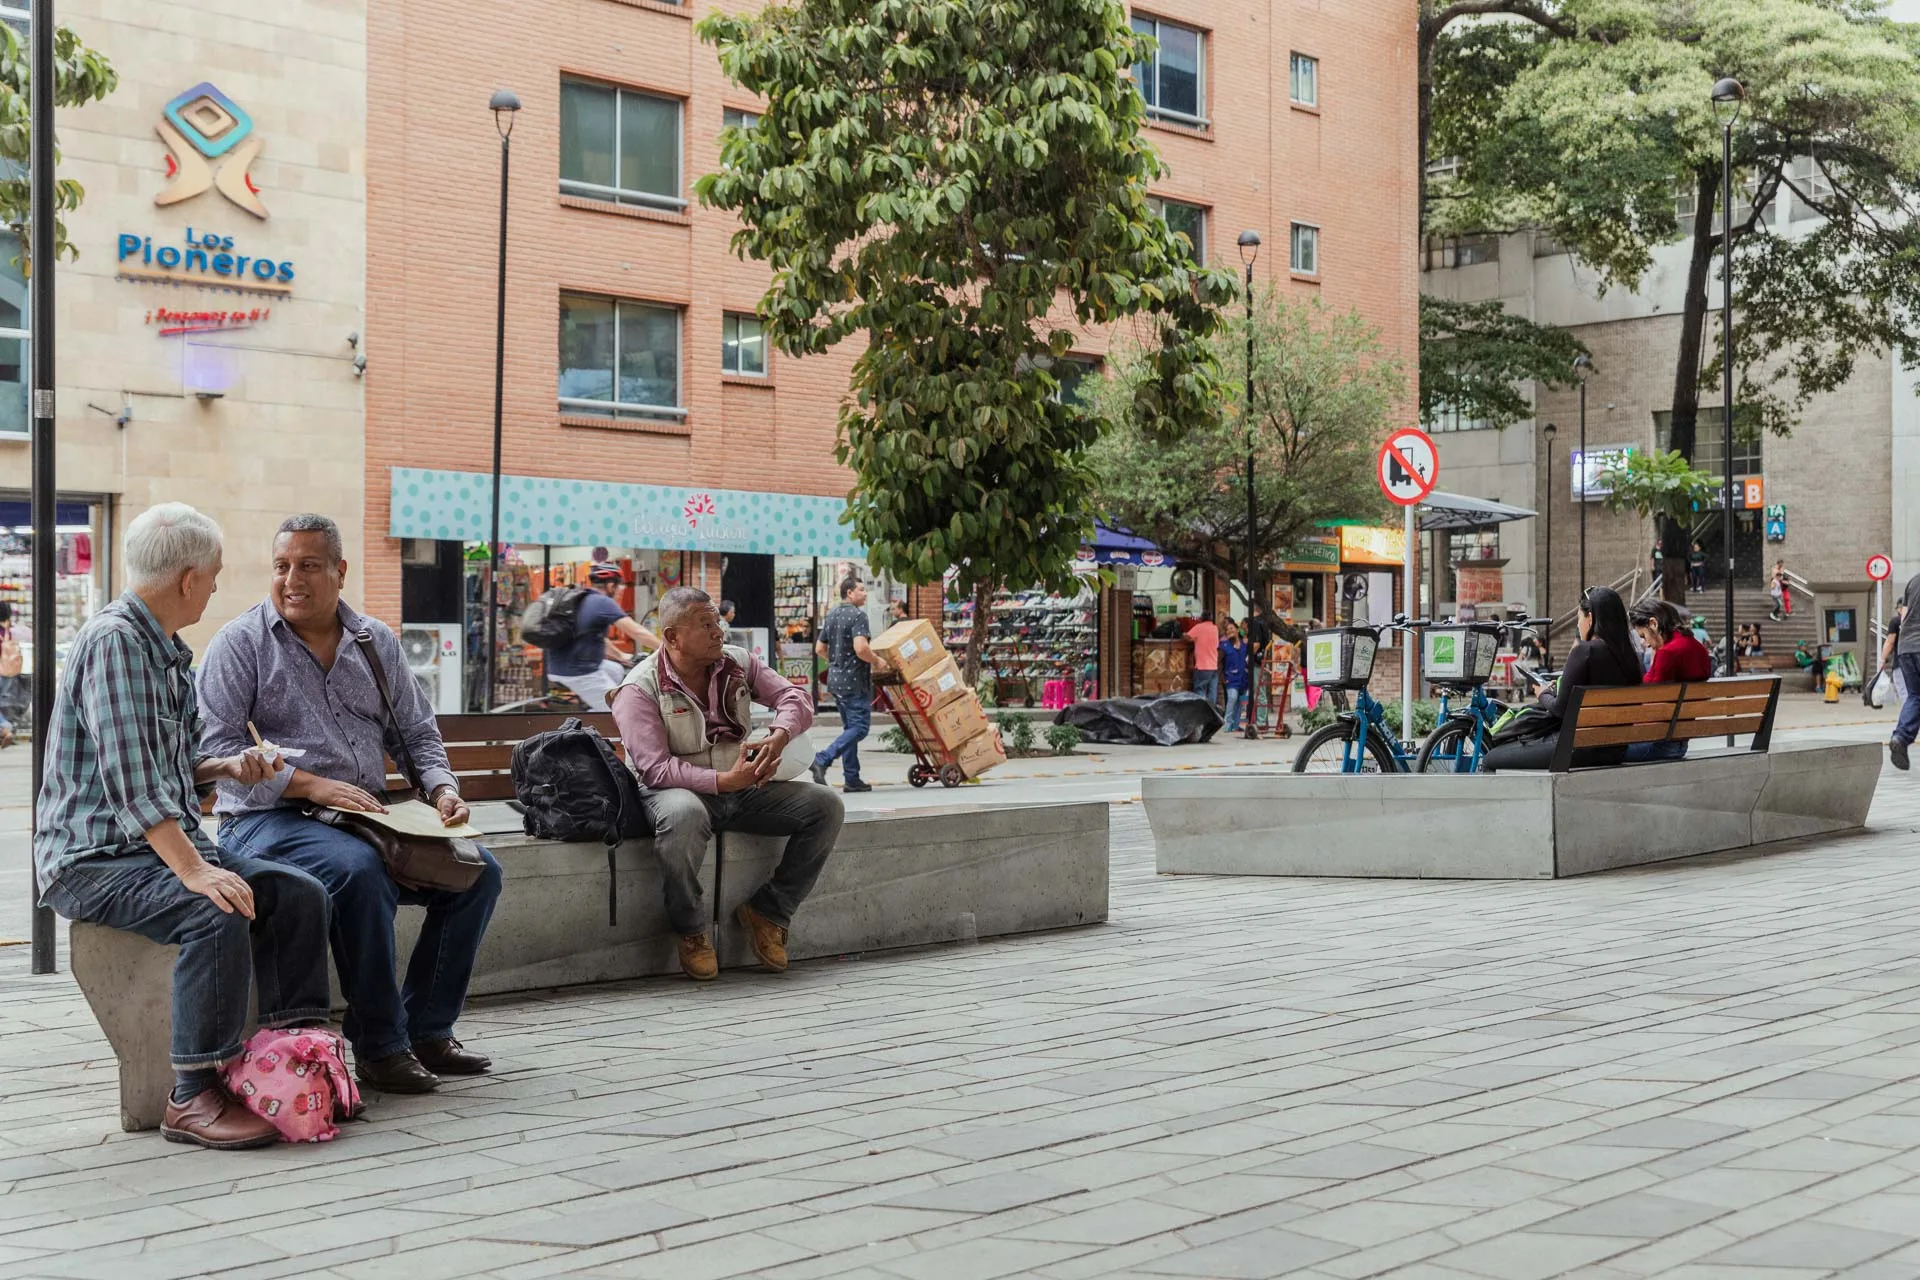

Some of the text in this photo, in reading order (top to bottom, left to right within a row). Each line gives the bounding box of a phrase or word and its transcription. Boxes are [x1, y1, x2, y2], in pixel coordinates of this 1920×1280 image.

[185, 227, 235, 249] Los
[118, 233, 295, 282] Pioneros
[1747, 484, 1761, 504] B
[1768, 504, 1784, 516] TA
[1771, 522, 1781, 534] A
